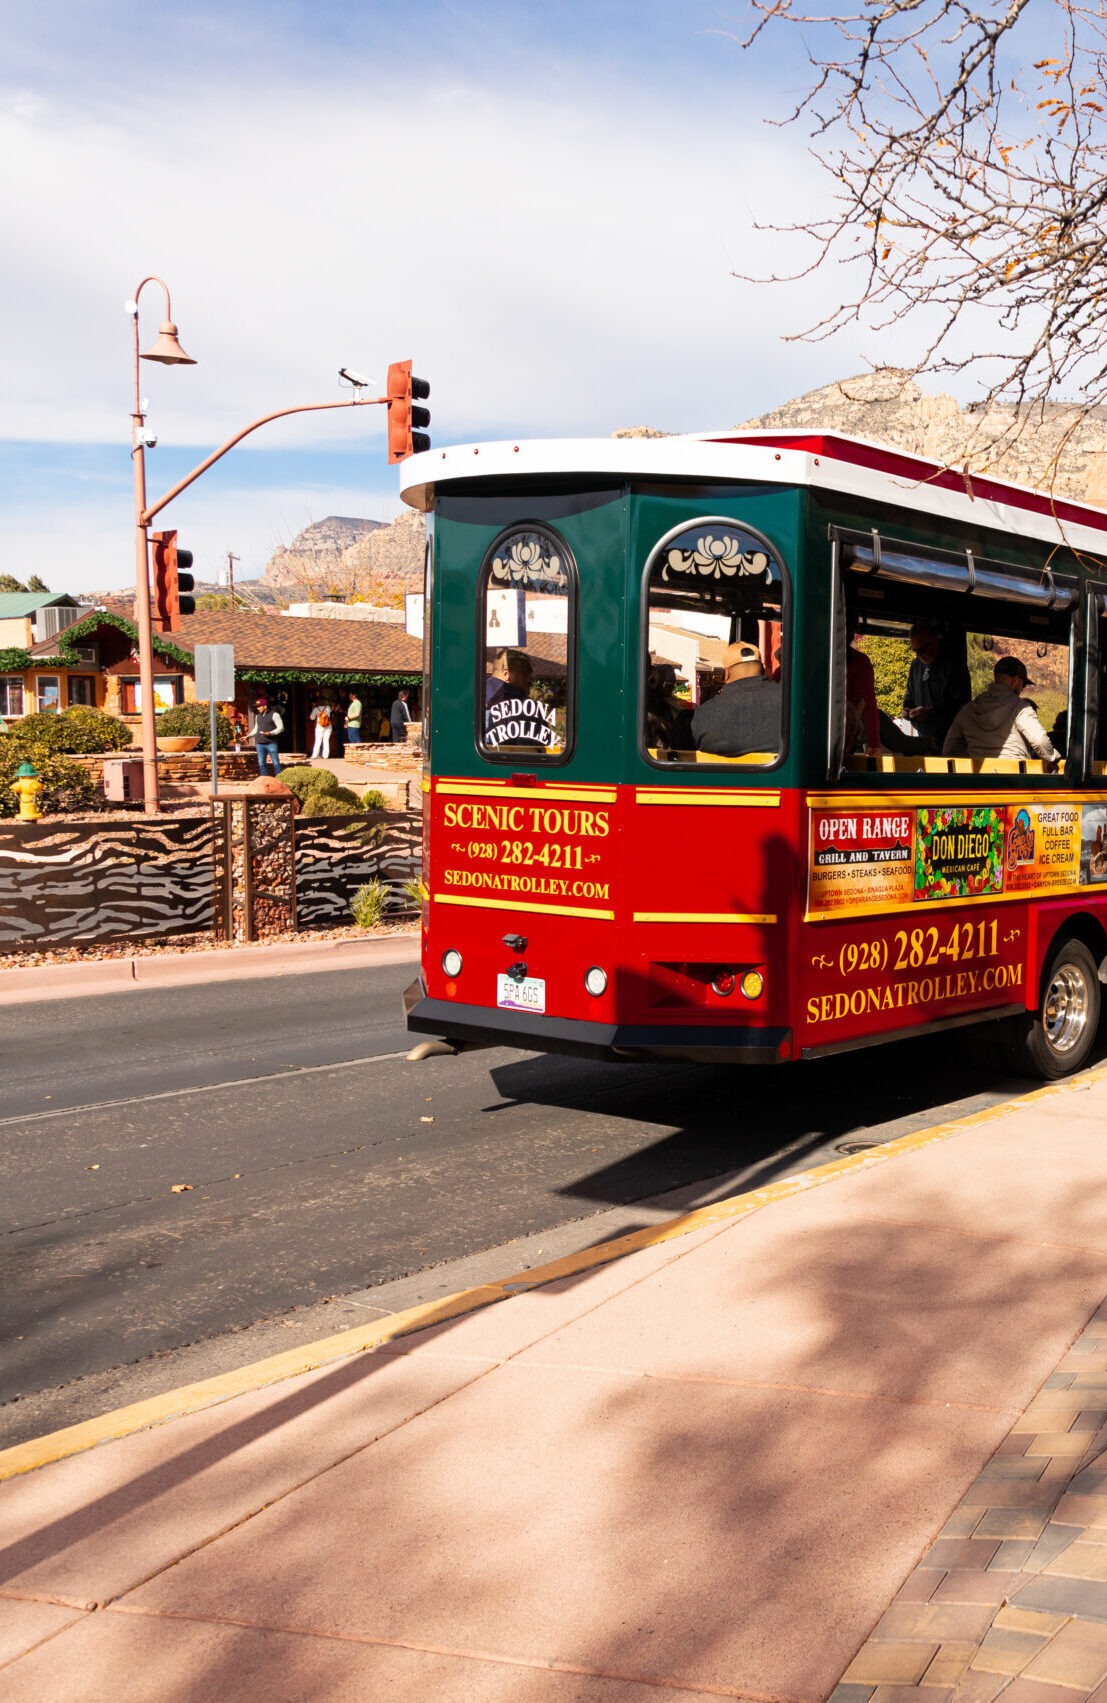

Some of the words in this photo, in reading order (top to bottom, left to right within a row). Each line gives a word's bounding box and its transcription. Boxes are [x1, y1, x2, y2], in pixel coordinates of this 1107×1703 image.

[490, 699, 557, 727] SEDONA
[485, 720, 561, 751] TROLLEY
[444, 803, 524, 831] SCENIC
[530, 808, 609, 837] TOURS
[819, 818, 857, 840] OPEN
[862, 817, 909, 839] RANGE
[1038, 812, 1059, 823] GREAT
[1061, 812, 1079, 822] FOOD
[1042, 826, 1059, 836] FULL
[1060, 826, 1073, 836] BAR
[468, 841, 498, 861] (928)
[501, 840, 583, 869] 282-4211
[818, 853, 847, 864] GRILL
[849, 851, 869, 862] AND
[872, 850, 908, 861] TAVERN
[932, 835, 955, 860] DON
[957, 834, 989, 859] DIEGO
[1044, 840, 1070, 850] COFFEE
[941, 864, 966, 873] MEXICAN
[1039, 854, 1050, 864] ICE
[1051, 853, 1074, 863] CREAM
[444, 869, 610, 900] SEDONATROLLEY.COM
[813, 870, 846, 881] BURGERS
[851, 868, 877, 878] STEAKS
[882, 866, 912, 876] SEAFOOD
[839, 938, 889, 976] (928)
[893, 919, 1000, 970] 282-4211
[806, 963, 1023, 1024] SEDONATROLLEY.COM
